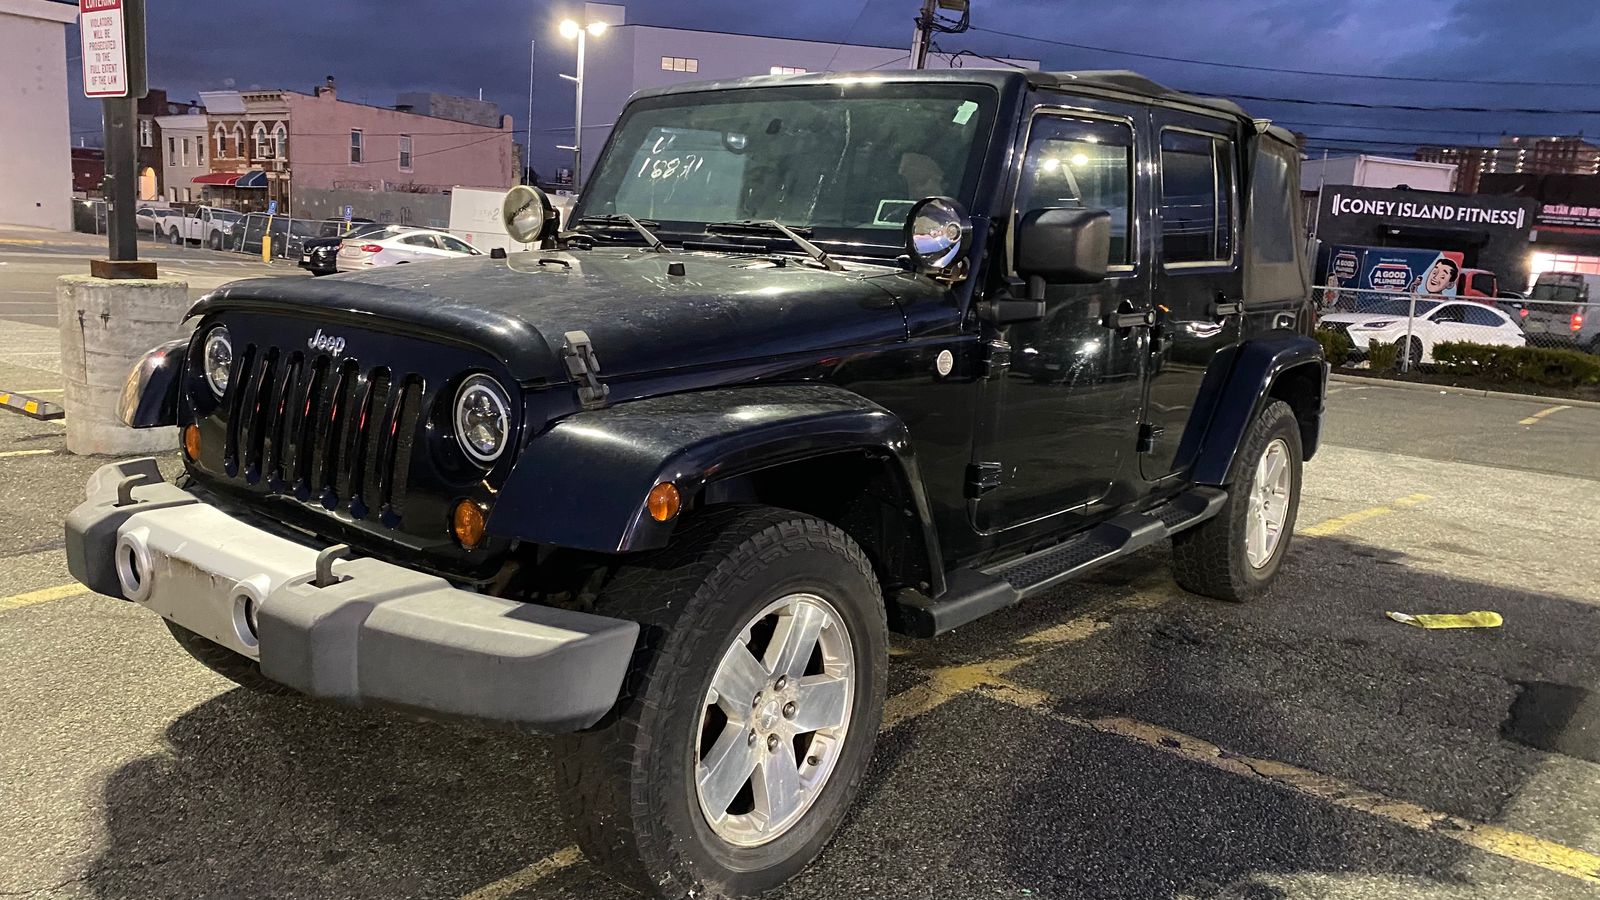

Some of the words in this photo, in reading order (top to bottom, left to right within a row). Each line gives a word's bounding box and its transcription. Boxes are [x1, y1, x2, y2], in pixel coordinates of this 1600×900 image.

[90, 17, 113, 28] VIOLATORS
[93, 30, 103, 39] WILL
[104, 29, 111, 39] BE
[89, 40, 116, 51] PROSECUTED
[95, 53, 101, 62] TO
[102, 52, 111, 62] THE
[90, 65, 101, 74] FULL
[102, 64, 117, 73] EXTENT
[91, 76, 98, 86] OF
[98, 76, 107, 85] THE
[107, 75, 117, 84] LAW
[1340, 198, 1396, 216] CONEY
[1397, 202, 1455, 220] ISLAND
[1456, 207, 1518, 225] FITNESS
[1569, 206, 1588, 216] AUTO
[1375, 270, 1382, 278] A
[1382, 271, 1407, 279] GOOD
[307, 328, 346, 357] Jeep
